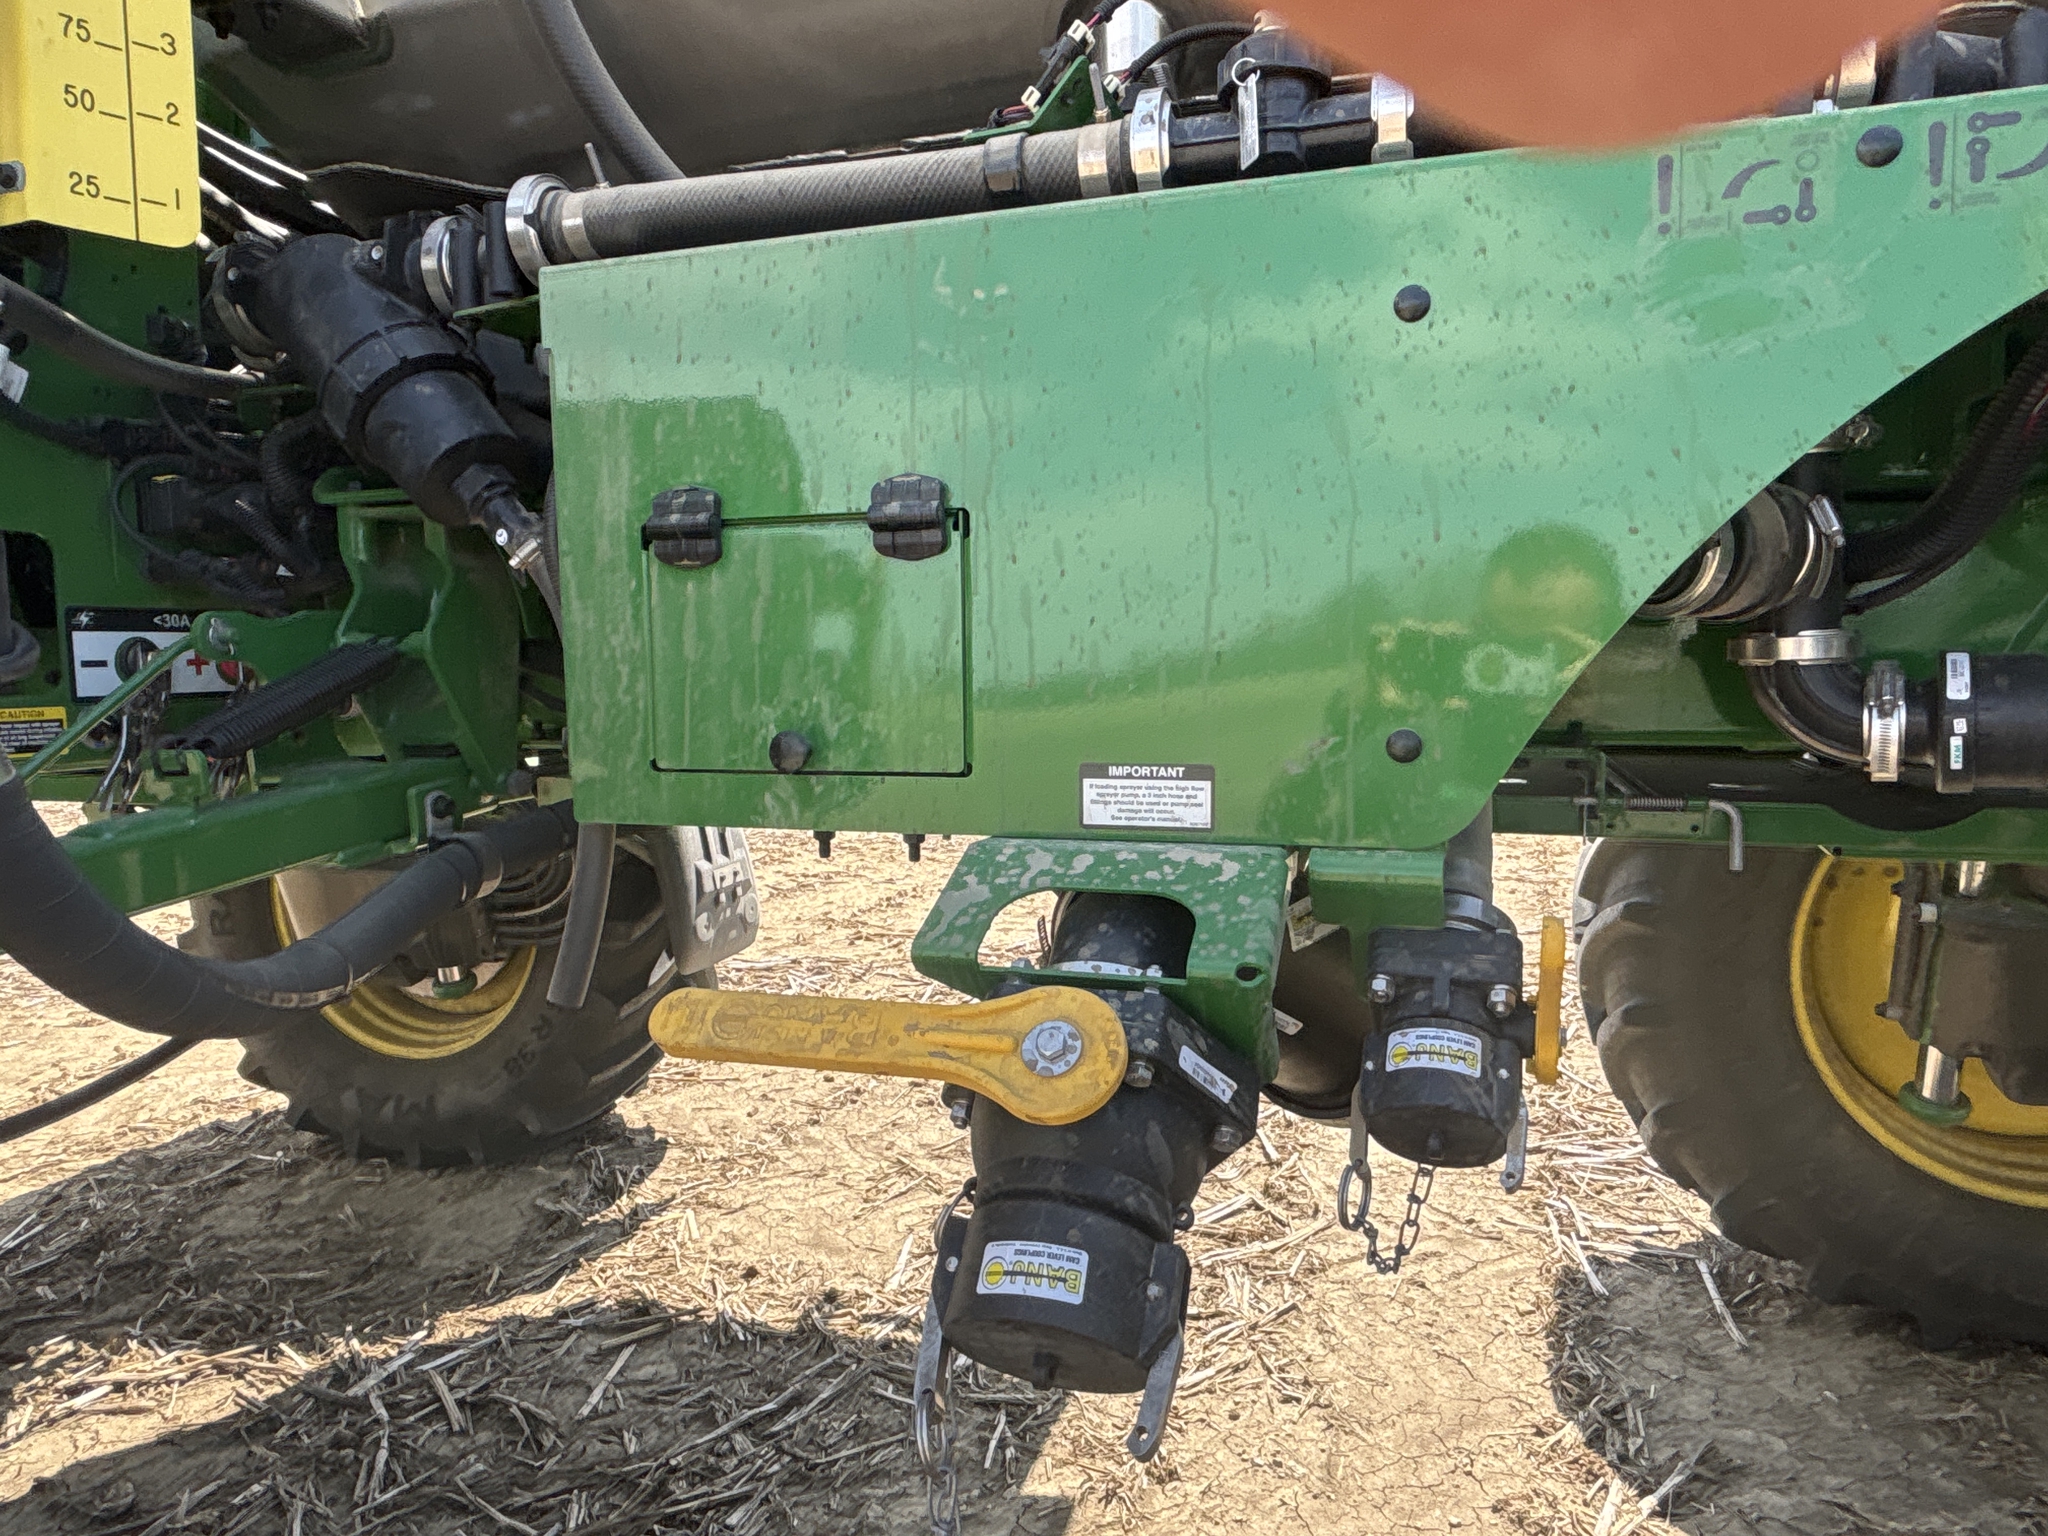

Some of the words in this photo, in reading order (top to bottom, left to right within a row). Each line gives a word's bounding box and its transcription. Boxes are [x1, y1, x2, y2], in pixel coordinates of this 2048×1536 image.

[58, 12, 91, 42] 75
[160, 32, 177, 56] 3
[63, 83, 95, 112] 50
[165, 101, 181, 126] 2
[69, 171, 100, 198] 25
[175, 187, 180, 210] 1
[153, 613, 191, 628] <30A
[0, 710, 45, 719] CAUTION
[1108, 765, 1185, 778] IMPORTANT
[982, 1256, 1082, 1295] BANJO
